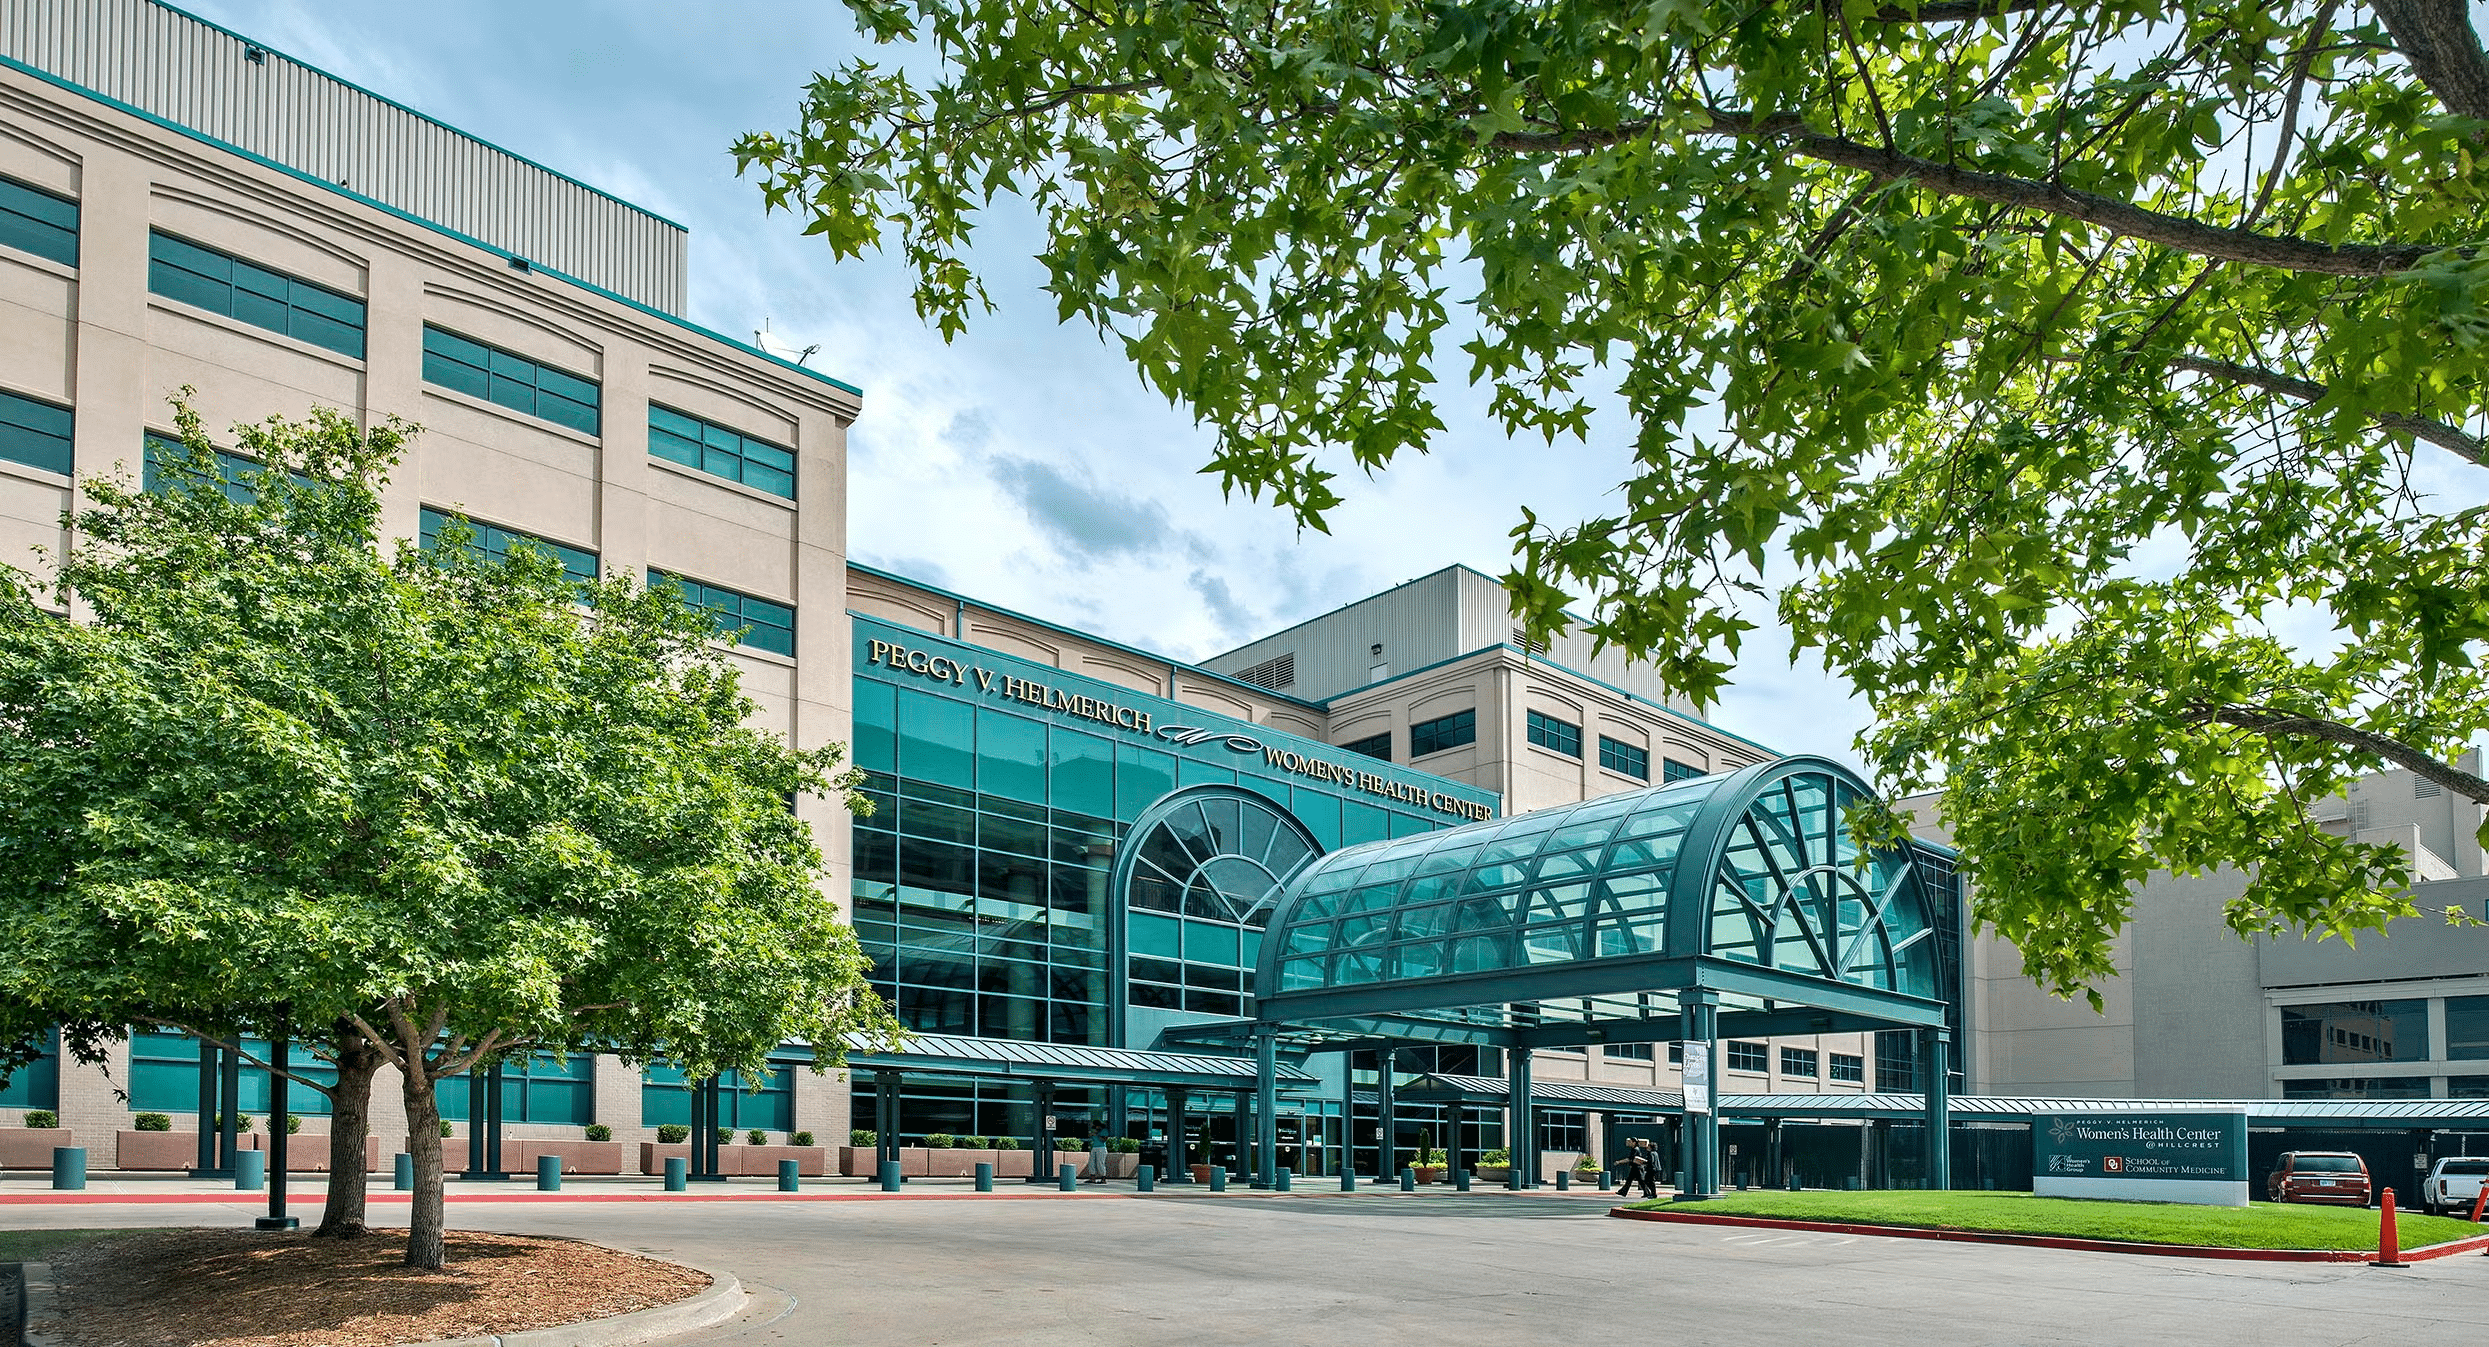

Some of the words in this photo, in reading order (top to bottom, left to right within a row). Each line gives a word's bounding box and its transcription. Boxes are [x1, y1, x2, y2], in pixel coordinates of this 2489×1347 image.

[870, 639, 969, 684] PEGGY
[974, 666, 997, 693] V.
[1004, 675, 1153, 733] HELMERICH
[1264, 746, 1356, 785] WOMEN'S
[1358, 771, 1429, 806] HEALTH
[1432, 792, 1493, 821] CENTER
[2077, 1127, 2130, 1140] Women's
[2133, 1127, 2174, 1140] Health
[2176, 1127, 2222, 1140] Center
[2125, 1157, 2160, 1165] SCHOOL
[2125, 1164, 2179, 1174] COMMUNITY
[2180, 1165, 2225, 1175] MEDICINE
